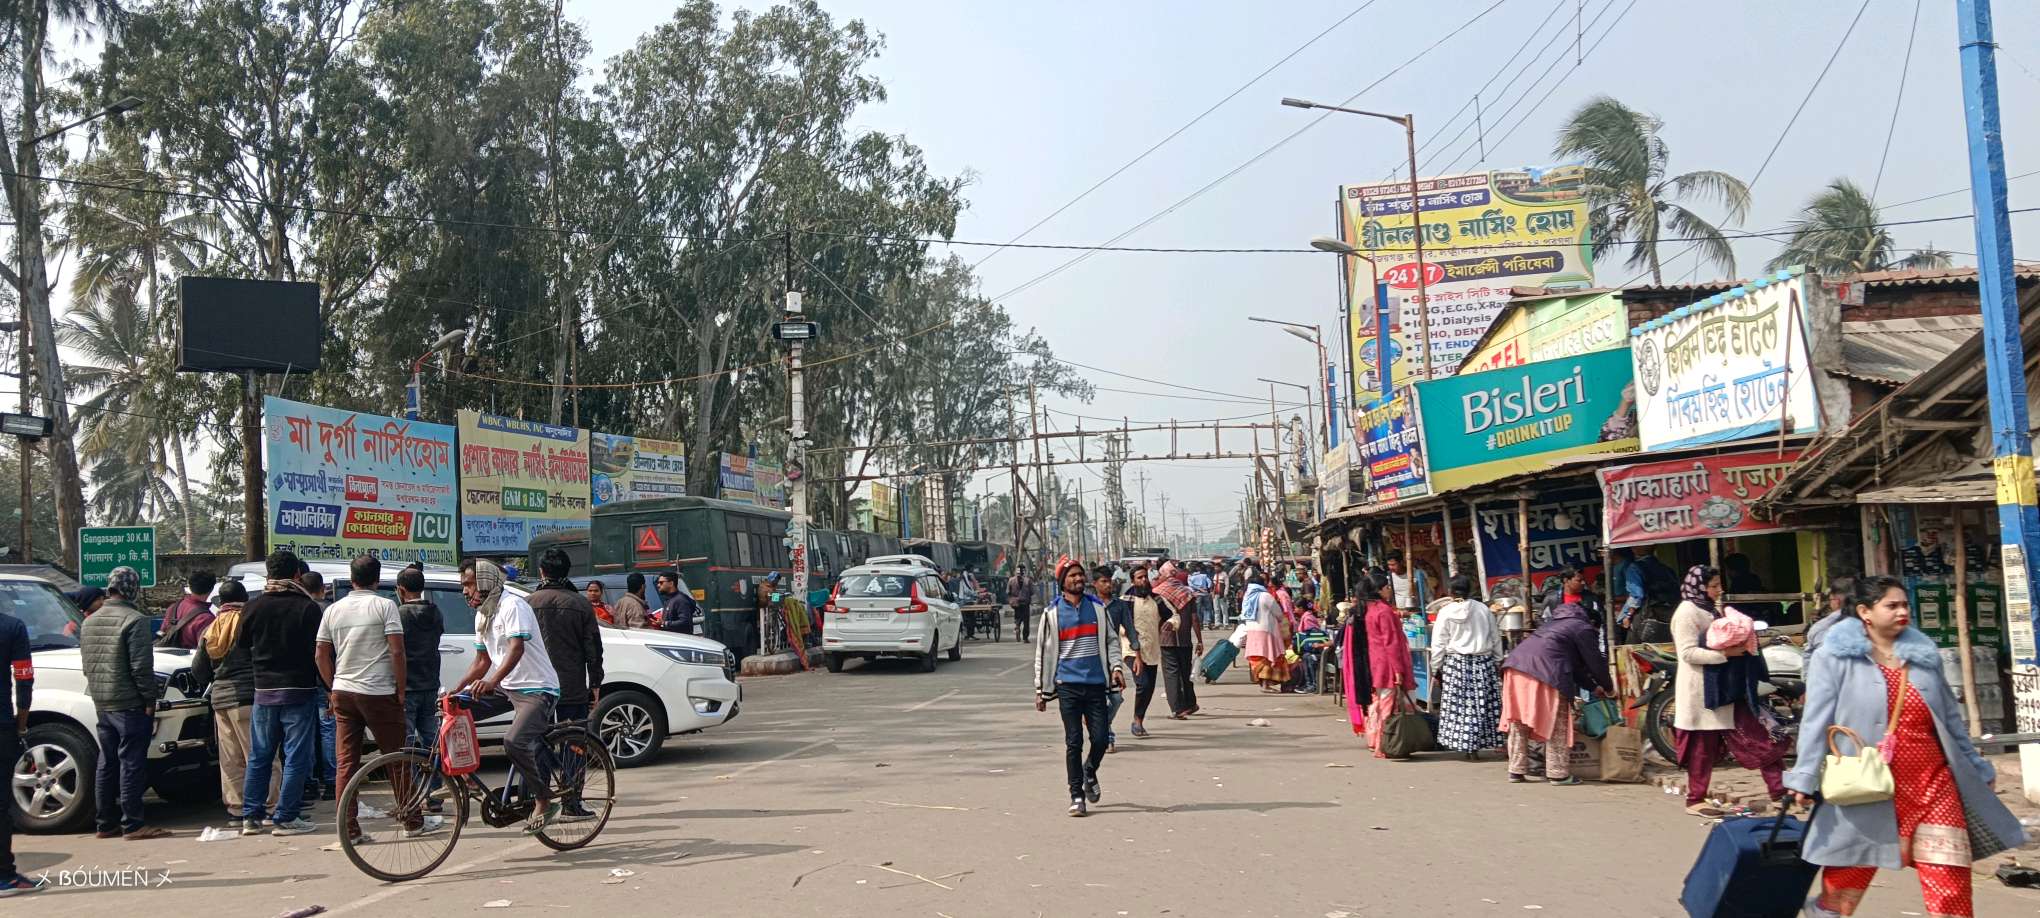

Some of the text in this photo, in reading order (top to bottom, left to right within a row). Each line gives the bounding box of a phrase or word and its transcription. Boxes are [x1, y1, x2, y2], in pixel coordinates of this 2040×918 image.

[1458, 207, 1517, 239] নার্সিং
[1525, 208, 1575, 236] হোম
[1388, 268, 1408, 285] 24
[1414, 330, 1451, 340] EHO,
[1443, 314, 1492, 326] Dialysis
[1415, 342, 1442, 351] TT,
[1474, 335, 1526, 371] OTEL
[1462, 365, 1587, 435] Bisleri
[285, 413, 450, 474] মা দুর্গা নার্সিংহোম
[1486, 413, 1573, 450] #DRINKITUP
[1611, 462, 1794, 507] शाकाहारी गुजरा
[417, 515, 449, 539] ICU
[1478, 498, 1603, 540] शाकाहा
[1634, 505, 1694, 533] खाना
[83, 533, 125, 545] Gangasagar
[126, 532, 135, 542] 30
